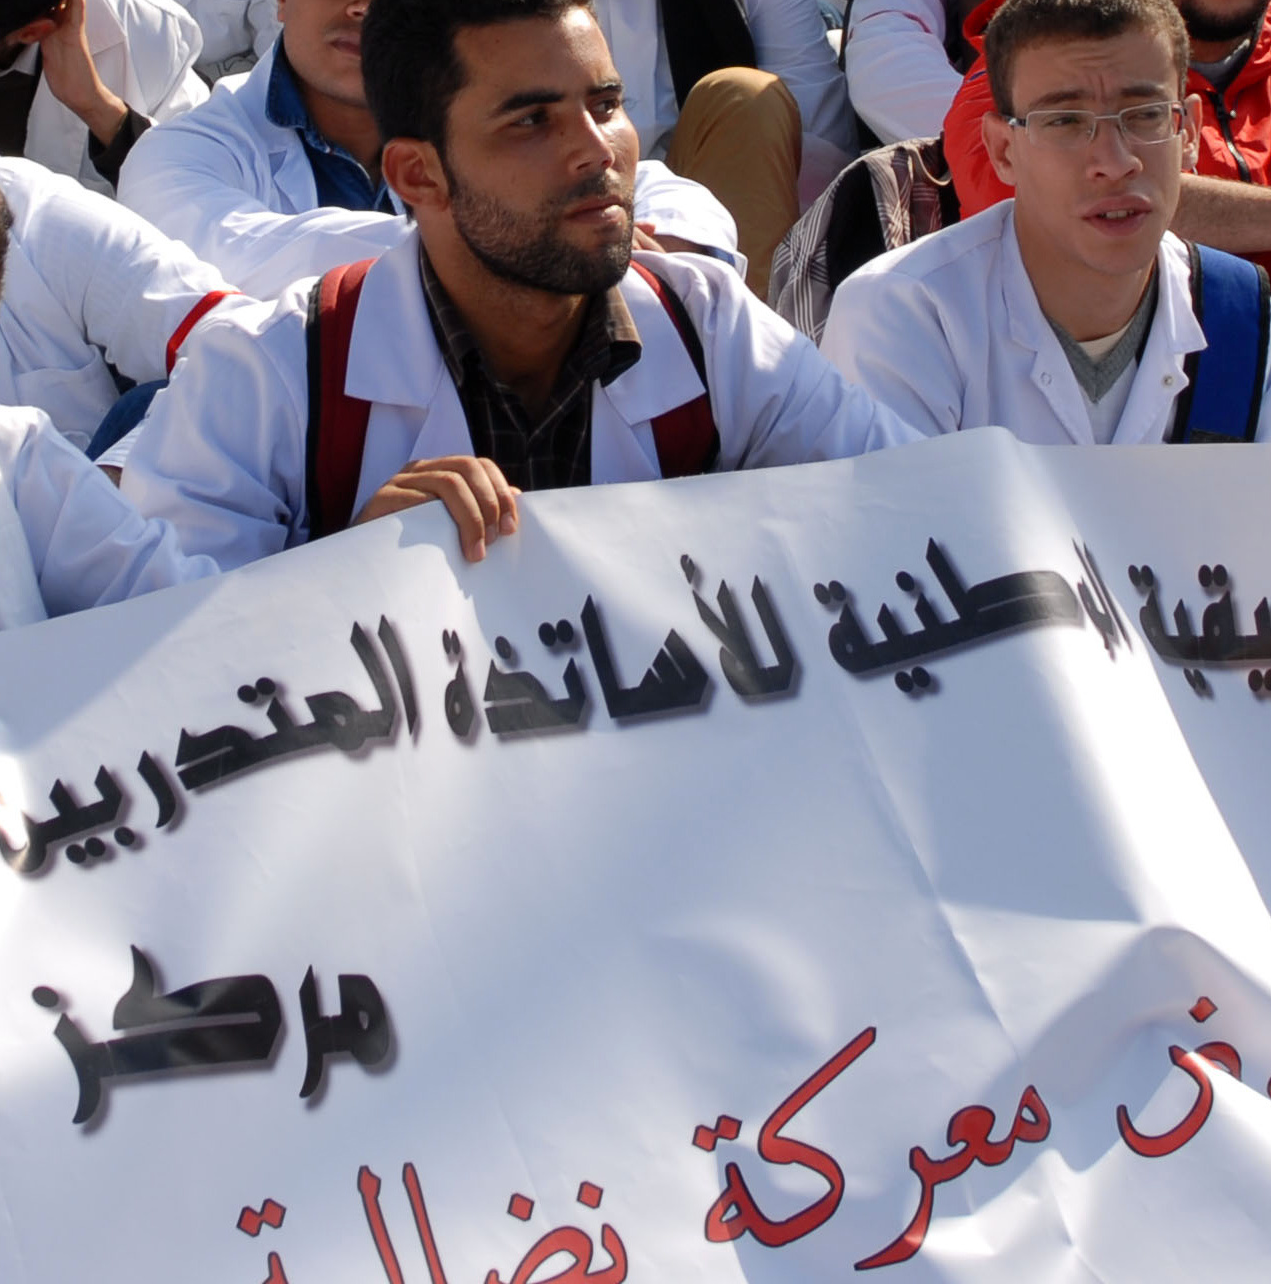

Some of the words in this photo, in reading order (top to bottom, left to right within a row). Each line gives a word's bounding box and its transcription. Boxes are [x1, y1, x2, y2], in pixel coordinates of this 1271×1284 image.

[442, 553, 801, 741] للأساتذة
[32, 944, 393, 1128] مركز
[692, 1025, 1052, 1272] معركة
